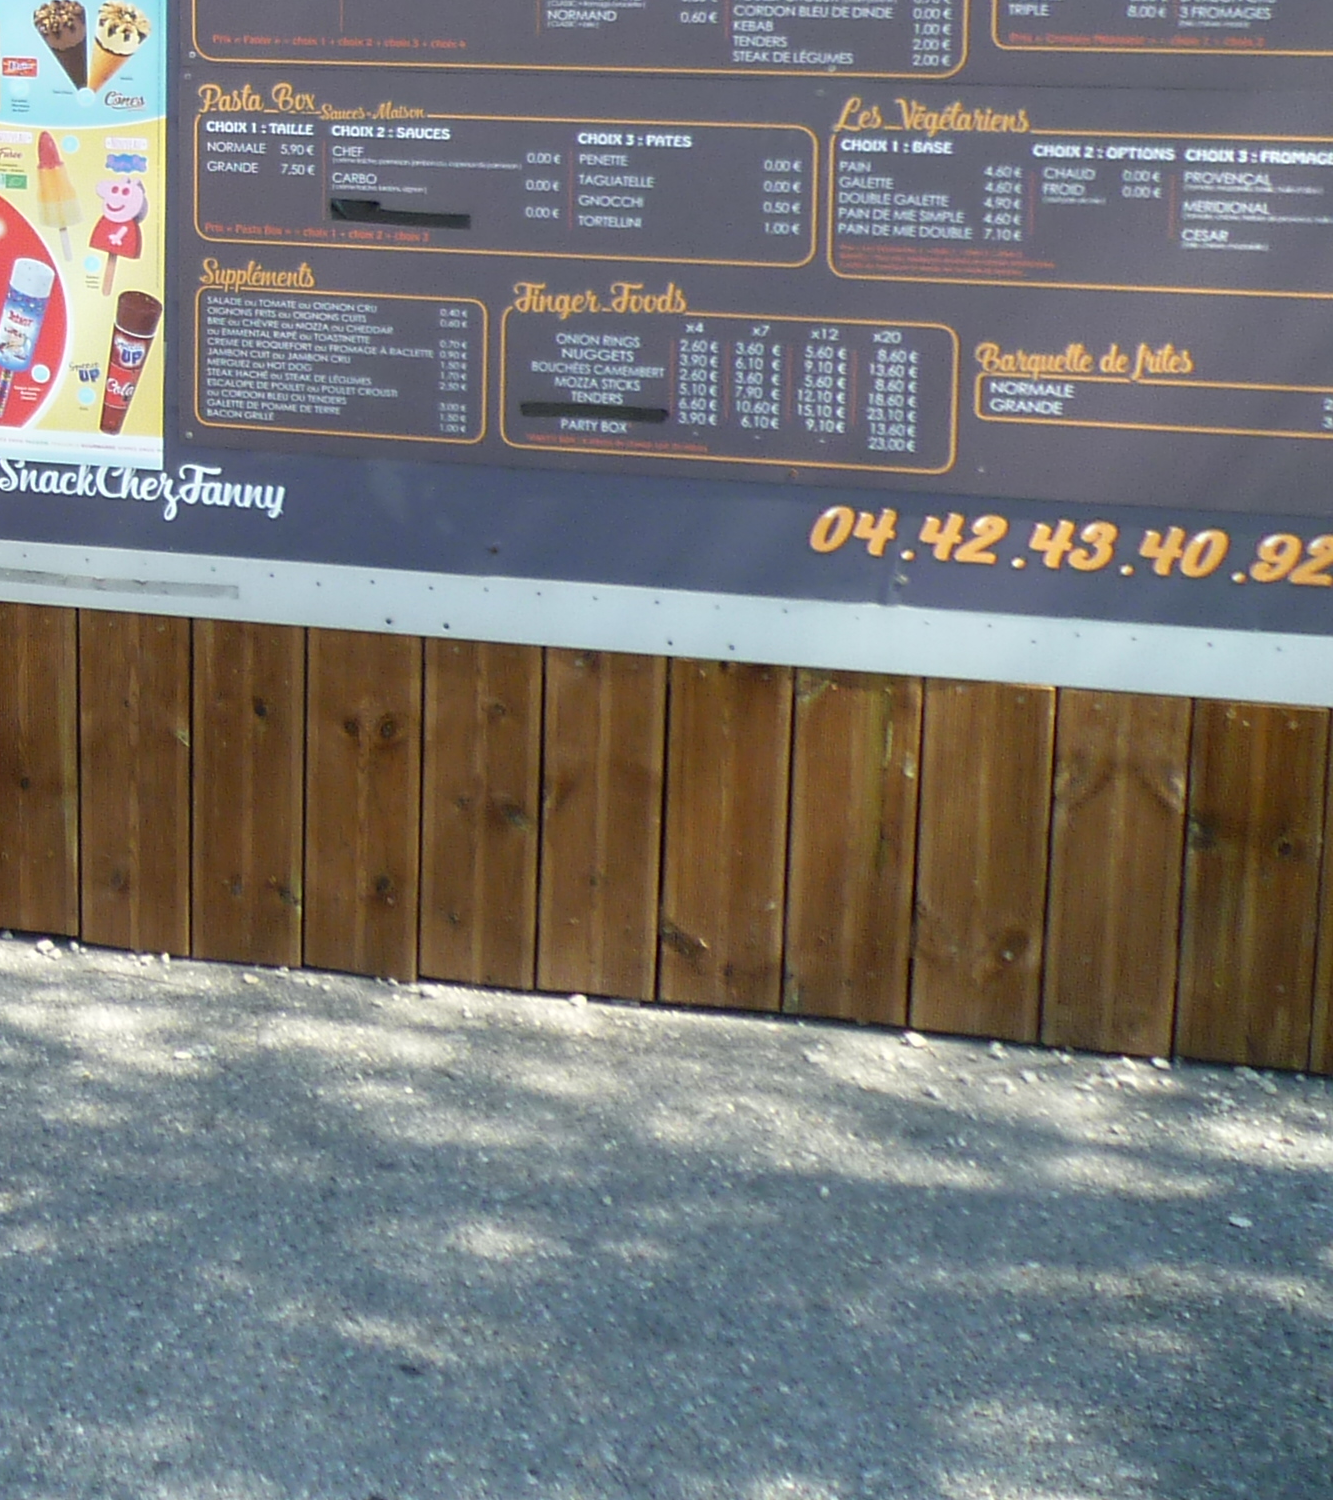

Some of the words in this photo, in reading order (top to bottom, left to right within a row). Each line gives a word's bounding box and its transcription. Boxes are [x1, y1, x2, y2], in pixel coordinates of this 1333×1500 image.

[198, 82, 265, 117] Pasta
[276, 82, 317, 114] Box
[832, 97, 884, 134] Les
[897, 98, 1032, 136] Végétariens
[199, 257, 316, 293] Suppléments
[513, 281, 601, 320] Finger
[608, 281, 688, 315] Foods
[121, 349, 144, 364] UP
[975, 342, 1093, 383] Barquette
[1100, 343, 1130, 375] de
[1132, 343, 1194, 383] frites
[78, 369, 101, 383] UP
[107, 378, 135, 398] Cola
[808, 504, 1333, 588] 04.42.43.40.92
